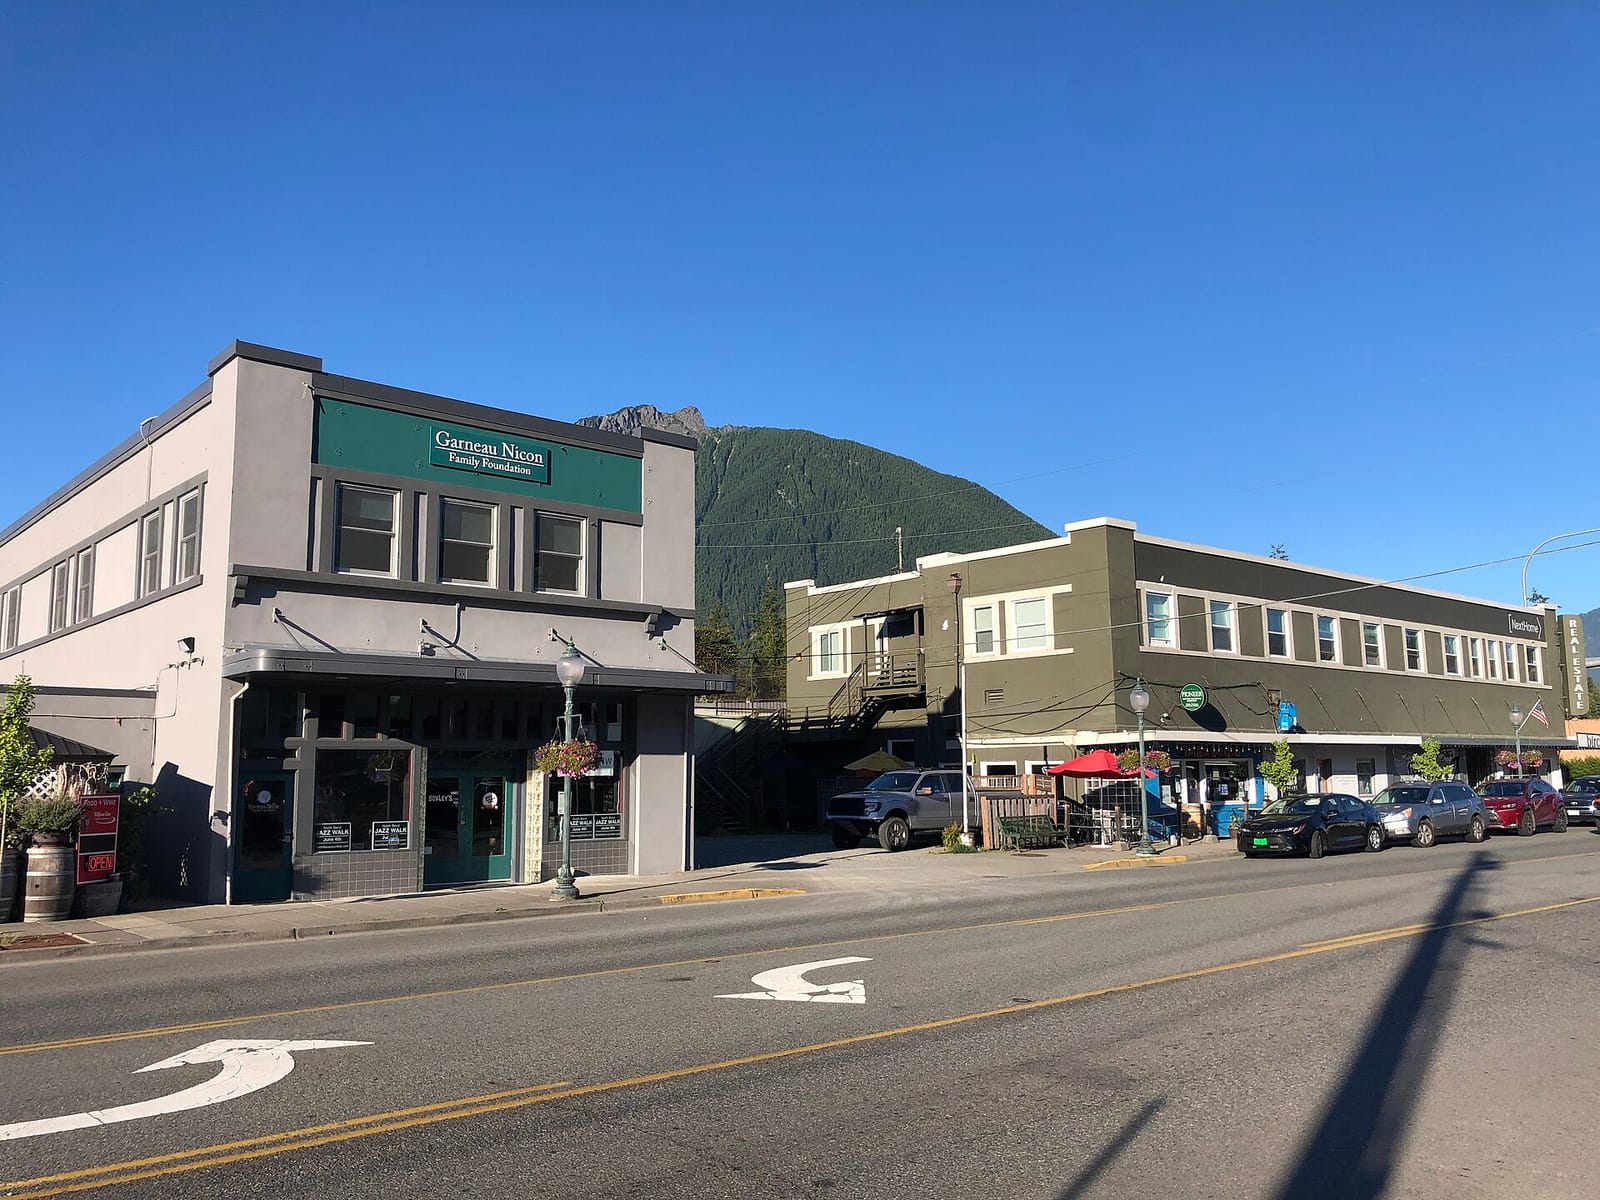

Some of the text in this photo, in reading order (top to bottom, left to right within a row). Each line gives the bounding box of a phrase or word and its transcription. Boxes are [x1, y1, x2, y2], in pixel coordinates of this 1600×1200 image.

[435, 430, 544, 464] Garneau Nicon
[449, 452, 532, 475] Family Foundation
[1511, 618, 1539, 633] NextHome
[1569, 619, 1580, 654] REAL
[1573, 658, 1584, 710] ESTATE
[90, 856, 112, 870] OPEN
